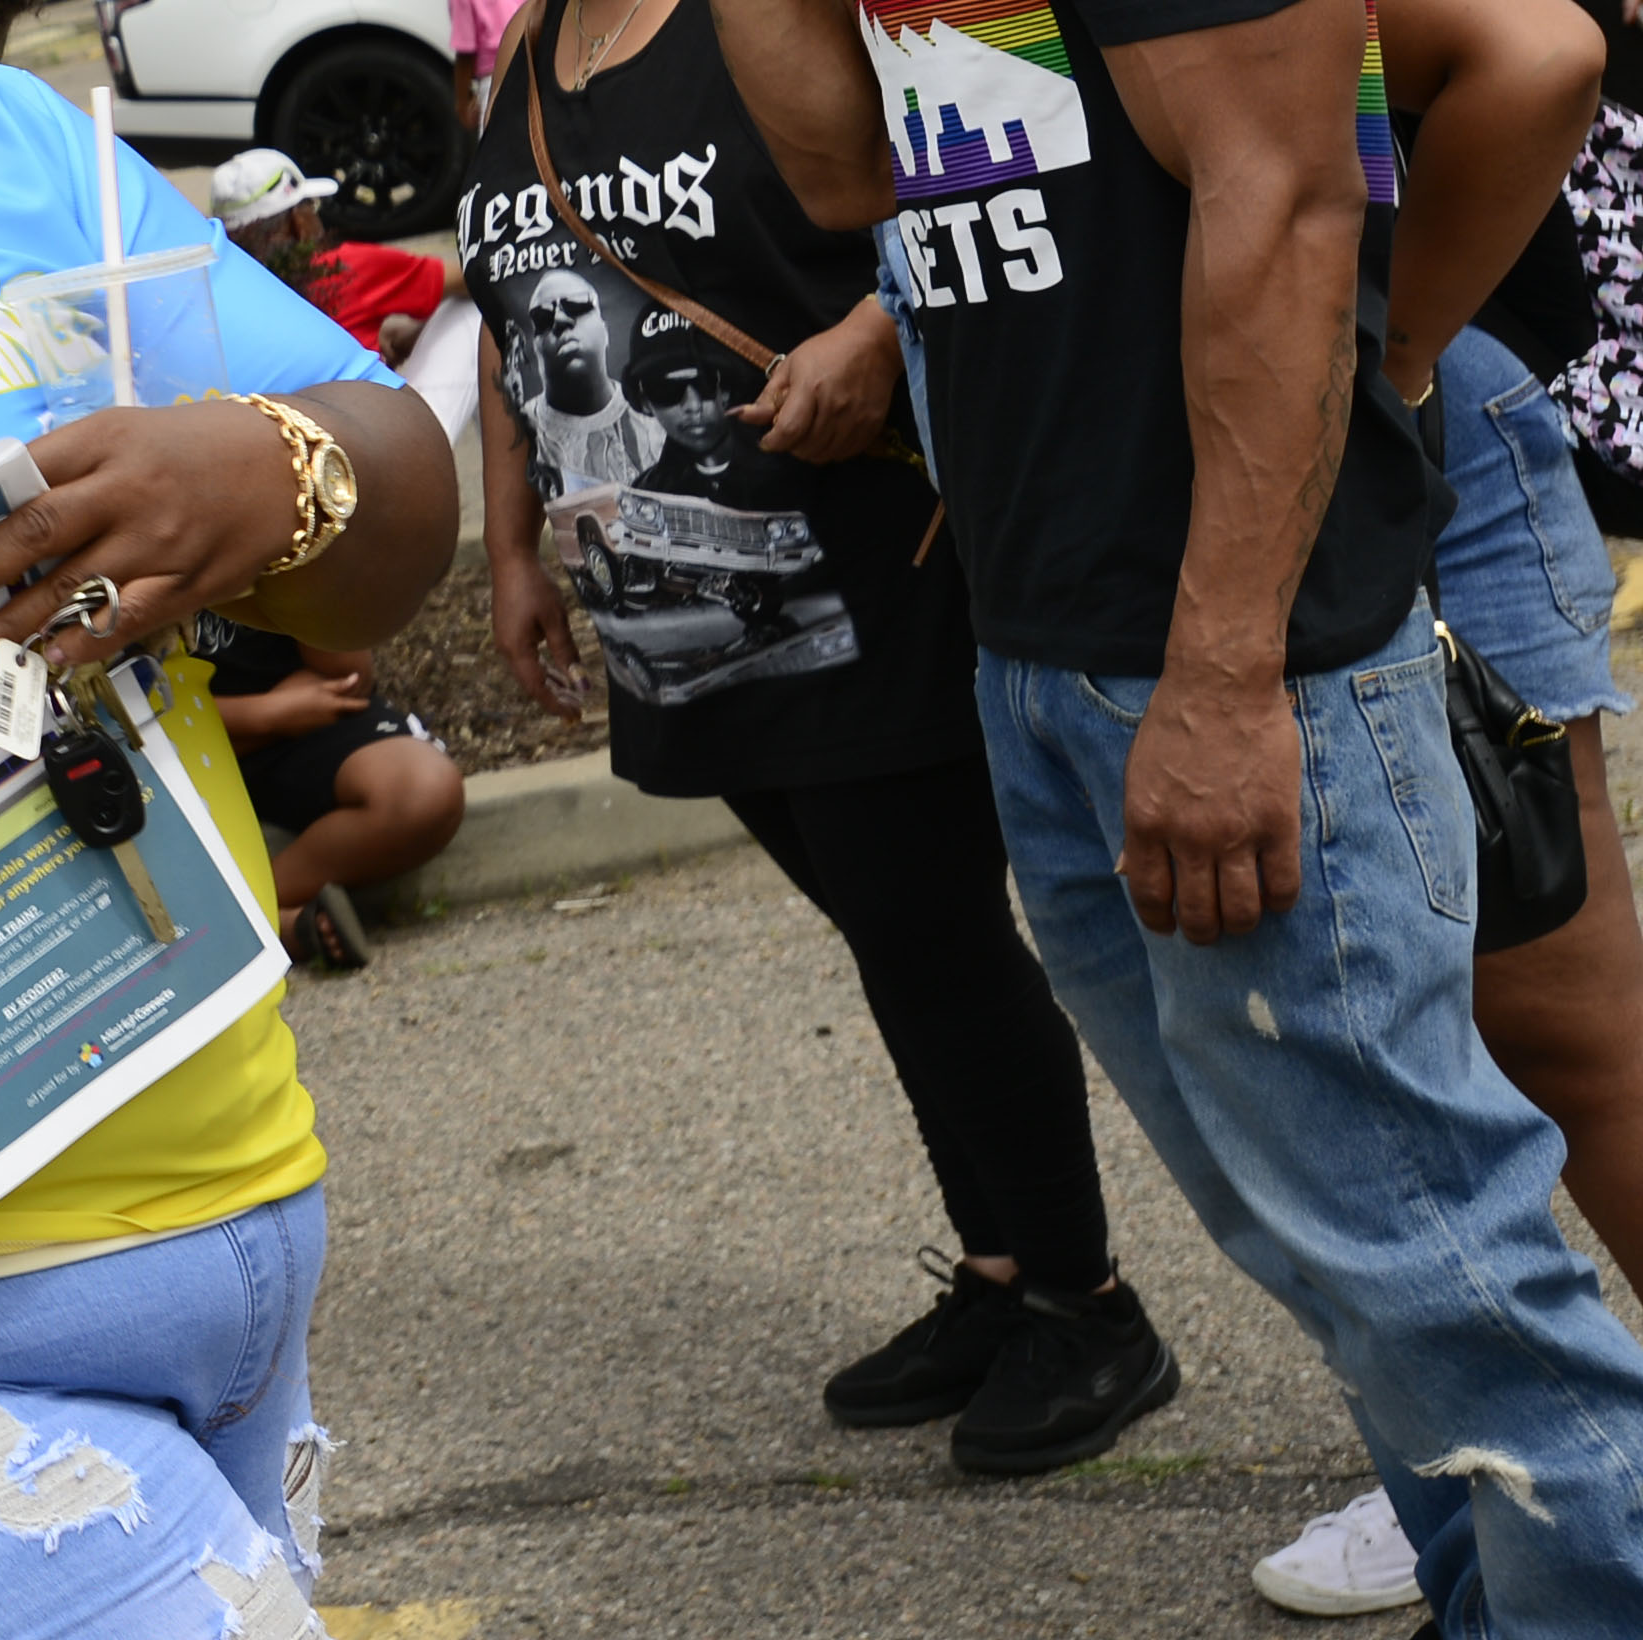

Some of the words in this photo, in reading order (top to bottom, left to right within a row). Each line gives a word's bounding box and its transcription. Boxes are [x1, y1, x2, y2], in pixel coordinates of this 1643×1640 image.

[489, 235, 578, 282] Never
[24, 834, 59, 865] ways
[54, 823, 71, 839] to
[3, 850, 67, 903] anywhere
[2, 902, 41, 937] TRAIN?
[18, 926, 36, 946] for
[31, 908, 60, 936] those
[56, 894, 79, 918] who
[68, 916, 81, 930] or
[1, 1000, 20, 1022] BY
[14, 965, 68, 1011] SCOOTER?
[29, 995, 55, 1021] fares
[51, 985, 69, 1004] for
[65, 968, 93, 994] those
[90, 953, 114, 976] who
[34, 1077, 58, 1102] paid
[52, 1068, 69, 1086] for
